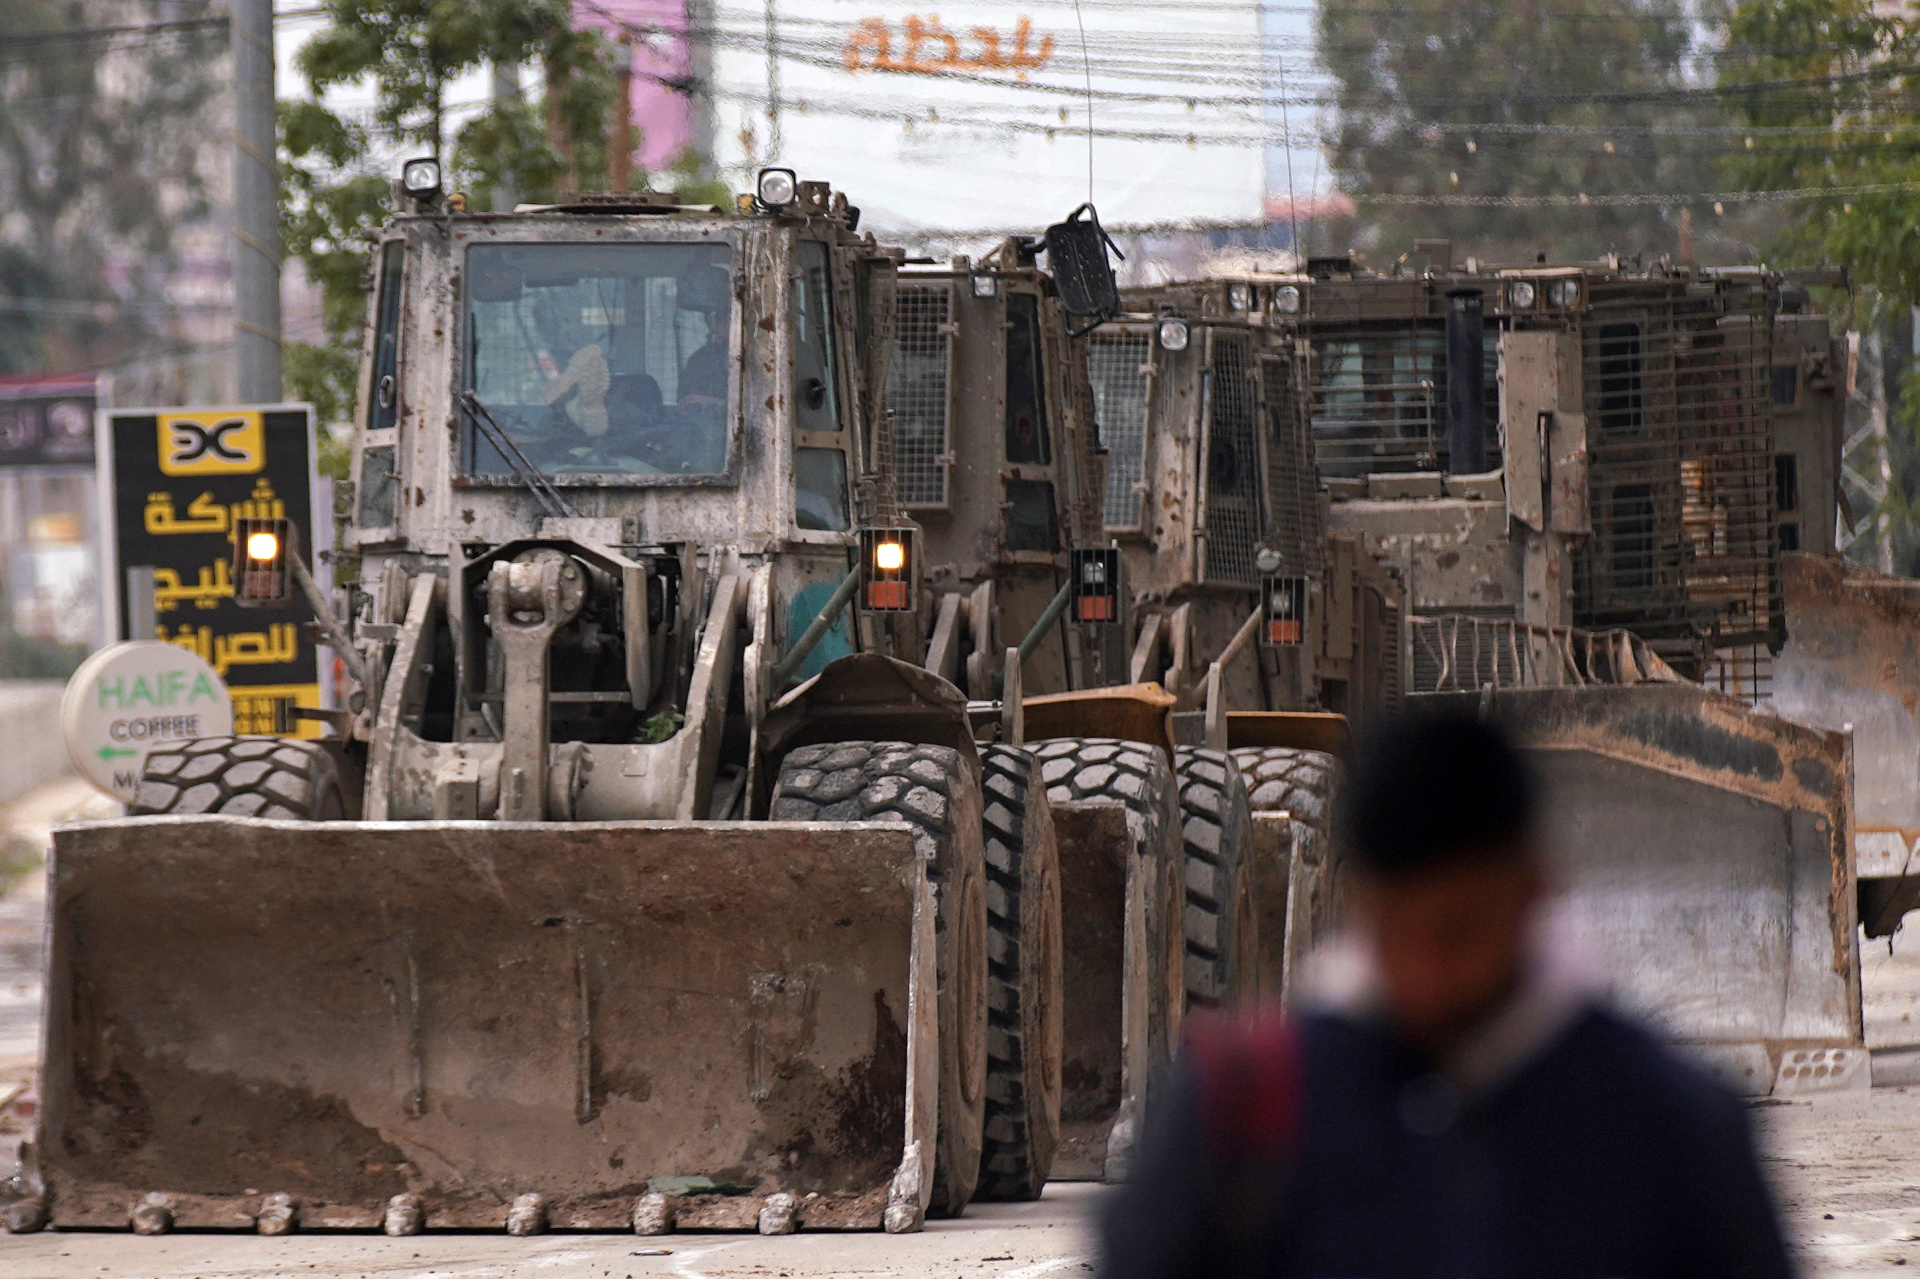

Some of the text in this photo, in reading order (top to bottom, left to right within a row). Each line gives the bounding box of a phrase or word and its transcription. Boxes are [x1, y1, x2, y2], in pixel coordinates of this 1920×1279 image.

[144, 477, 285, 544] شركة
[97, 671, 220, 709] HAIFA
[109, 714, 199, 743] COFFEE
